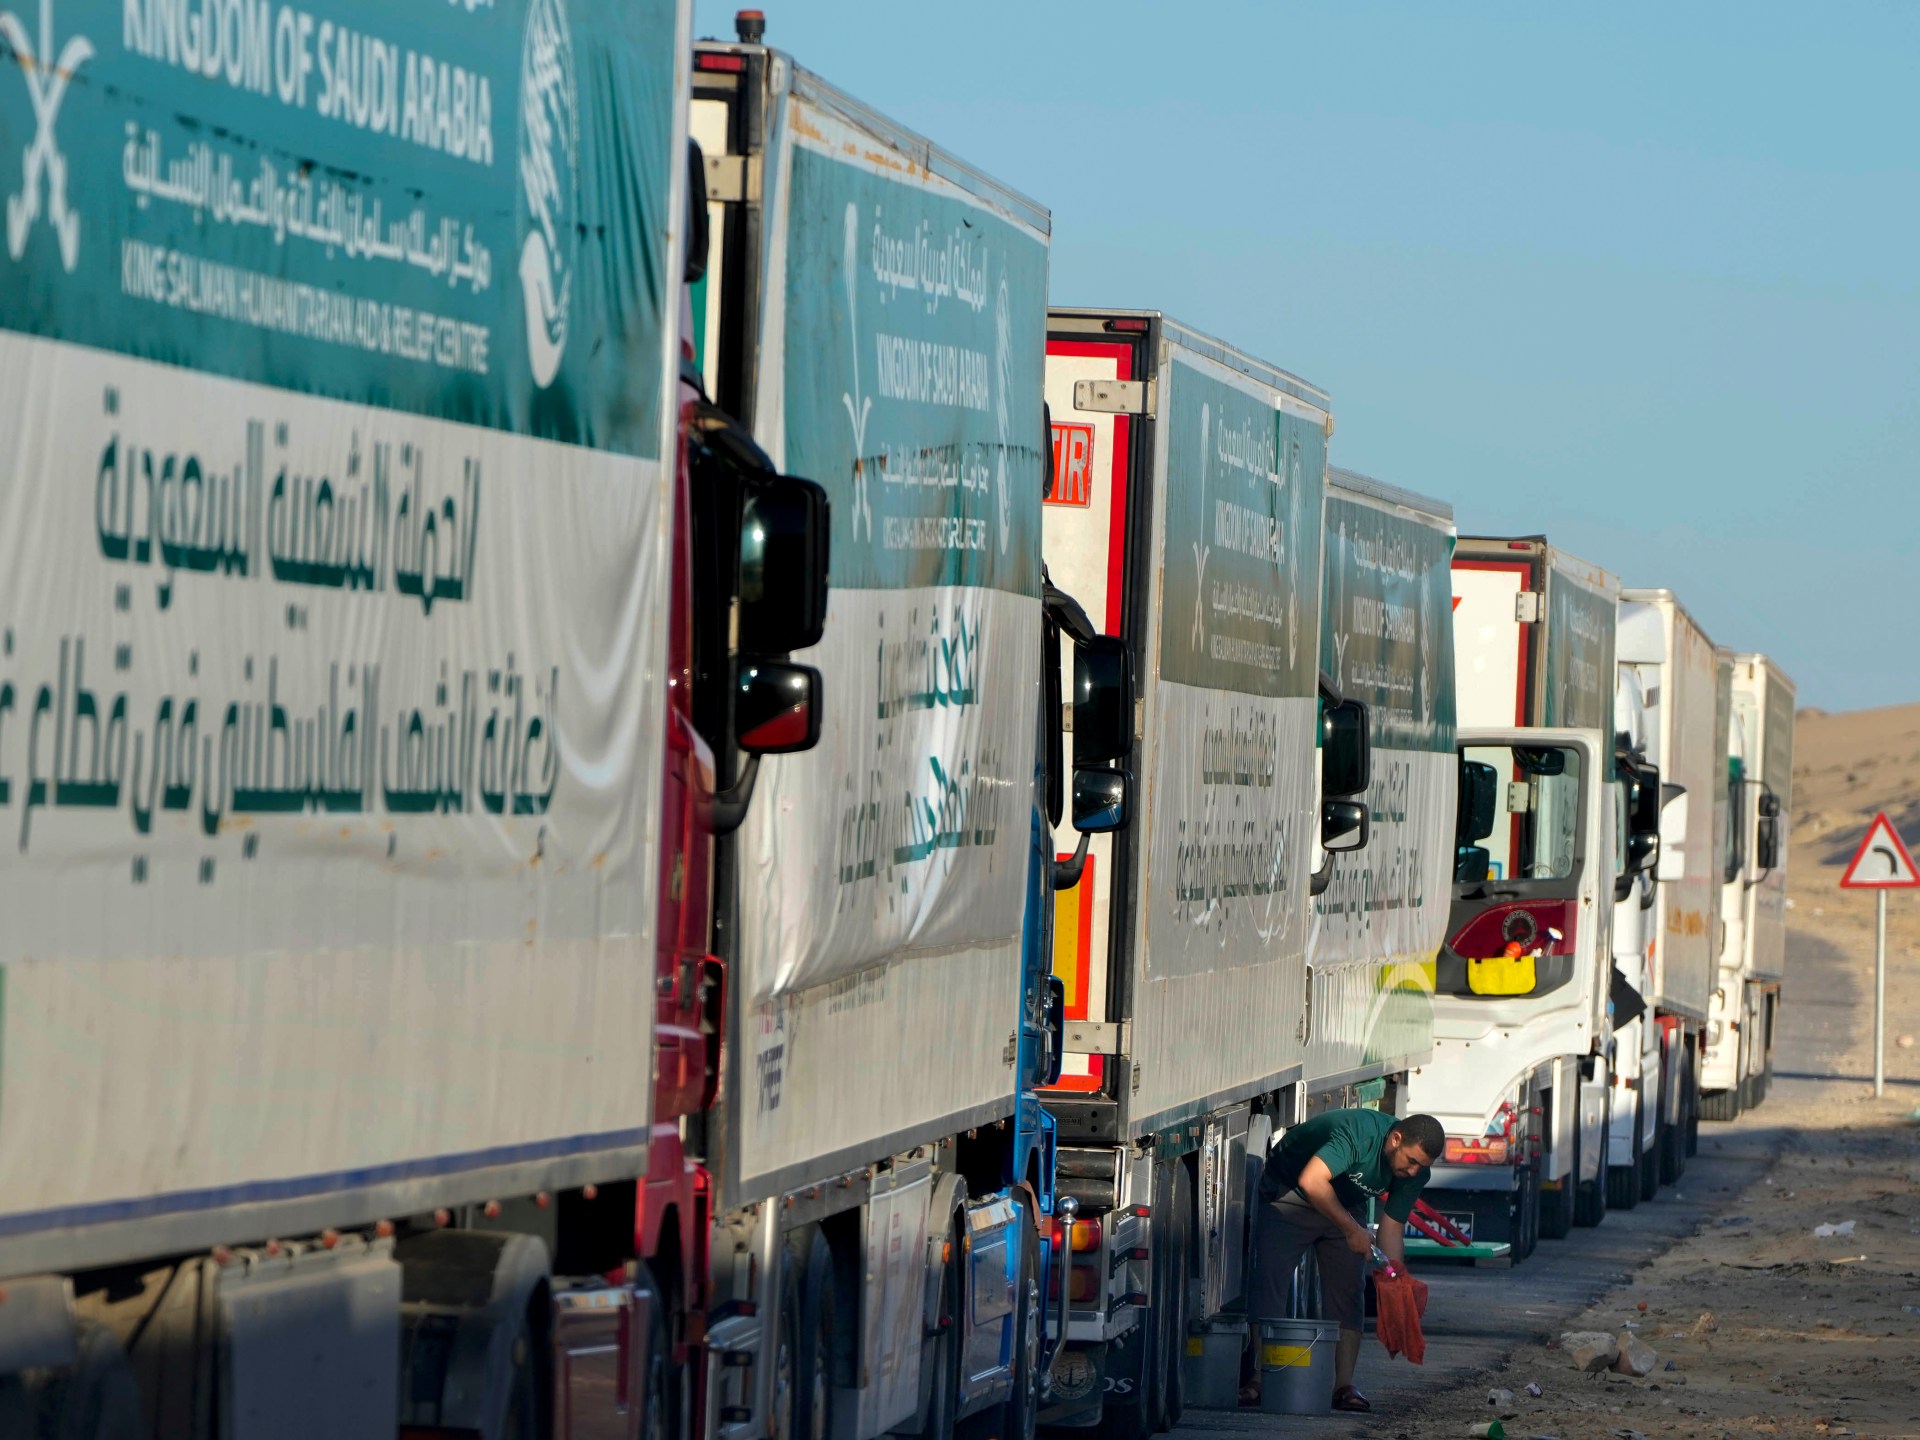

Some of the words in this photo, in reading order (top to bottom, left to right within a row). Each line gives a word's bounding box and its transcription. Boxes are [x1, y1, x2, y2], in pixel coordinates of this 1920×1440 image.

[123, 0, 272, 97] KINGDOM
[275, 4, 313, 108] OF
[317, 19, 398, 138] SAUDI
[399, 49, 493, 167] ARABIA
[121, 237, 167, 303] KING
[166, 250, 237, 323] SALMAN
[872, 204, 919, 304] السعودية
[920, 218, 952, 315] العربية
[953, 226, 987, 313] المملكة
[876, 331, 920, 402] KINGDOM
[919, 340, 932, 403] OF
[932, 343, 958, 407] SAUDI
[958, 347, 990, 413] ARABIA
[95, 384, 265, 612] السعودية
[1049, 427, 1089, 503] TIR
[395, 441, 481, 618] الحملة
[1214, 498, 1242, 552] KINGDOM
[1241, 507, 1250, 555] OF
[19, 635, 130, 853] قطاع
